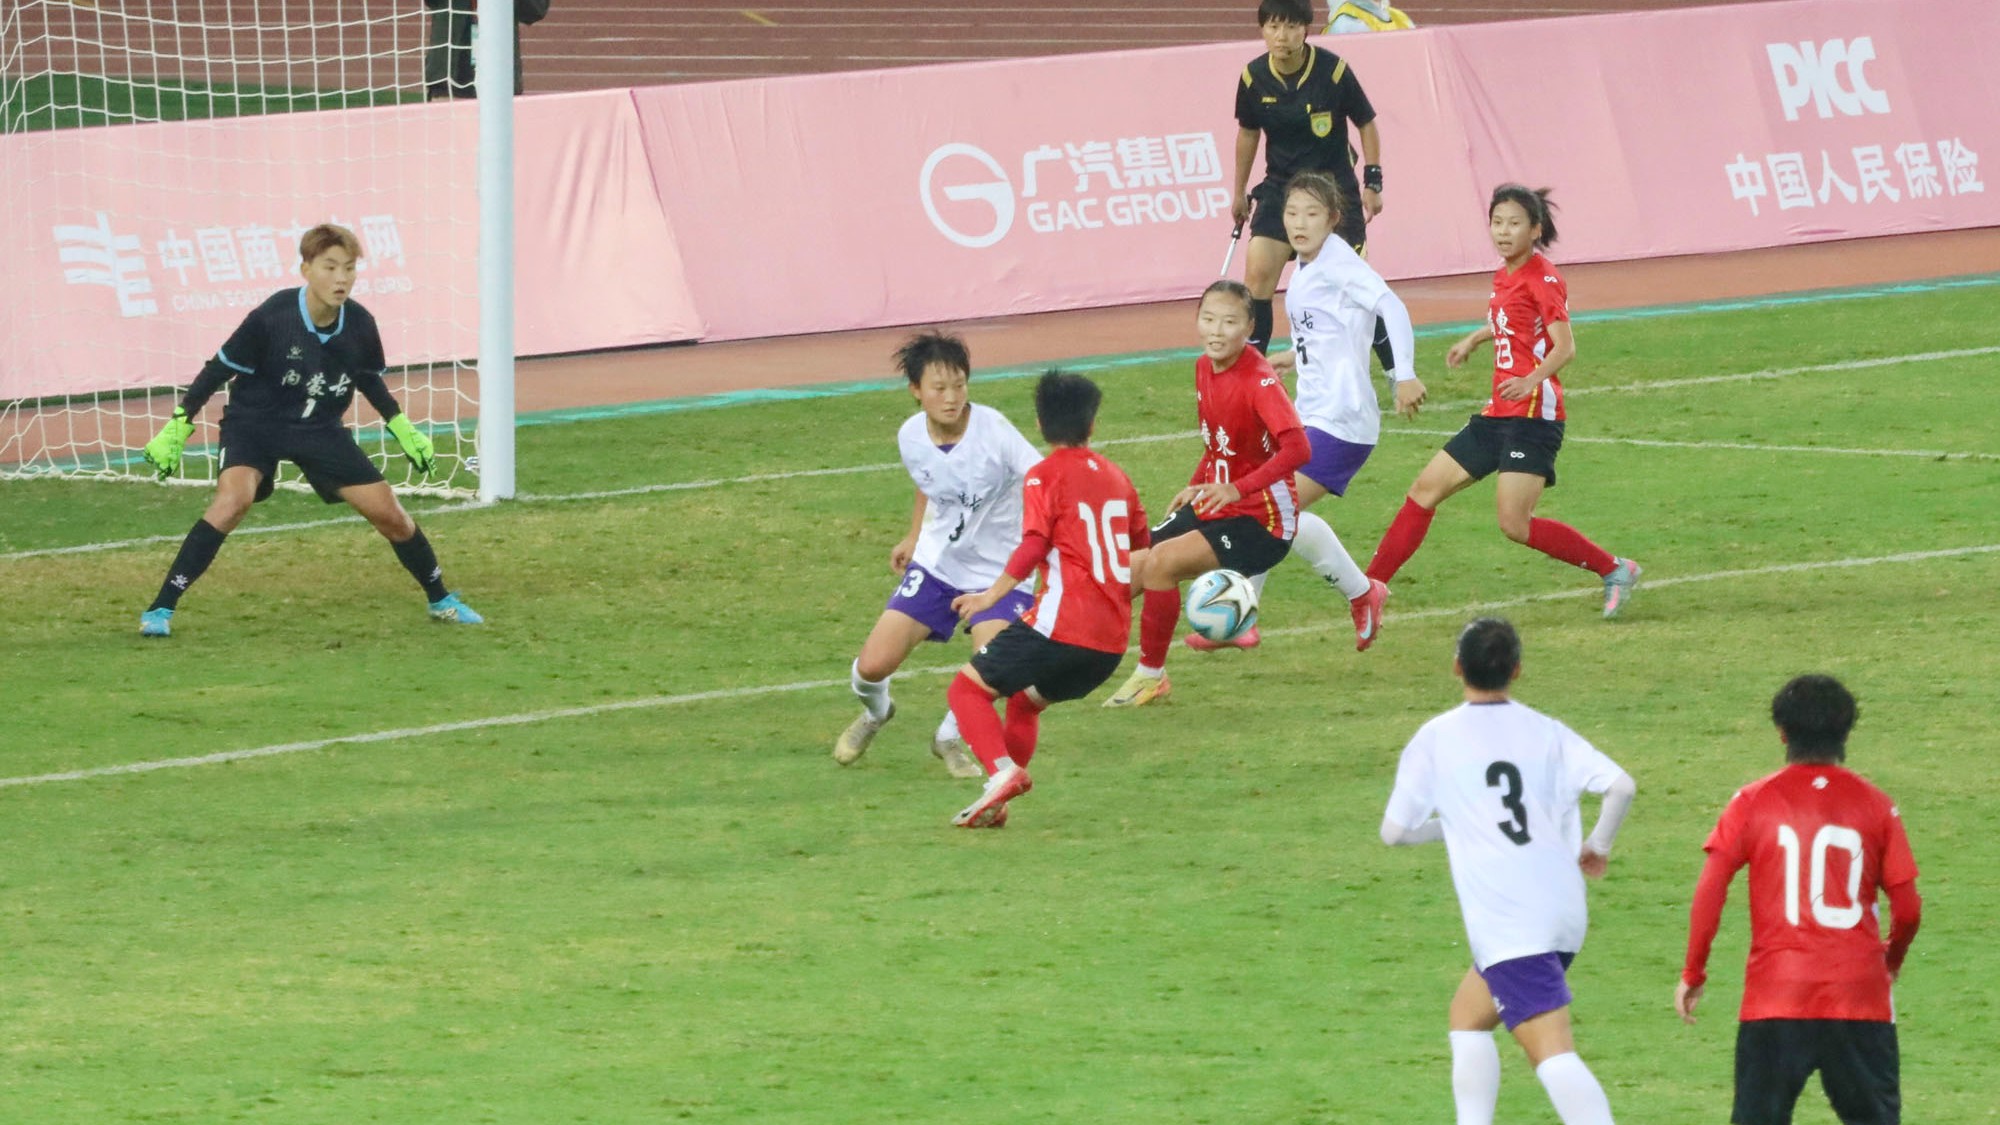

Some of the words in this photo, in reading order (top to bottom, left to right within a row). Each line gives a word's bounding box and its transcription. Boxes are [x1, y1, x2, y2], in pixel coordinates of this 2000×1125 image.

[1766, 36, 1891, 121] PICC
[1022, 132, 1223, 197] 广汽集团
[1725, 137, 1984, 217] 中国人民保险
[1027, 199, 1104, 233] GAC
[1106, 187, 1231, 226] GROUP
[301, 398, 317, 419] 1
[1486, 760, 1532, 846] 3
[1778, 824, 1864, 930] 10
